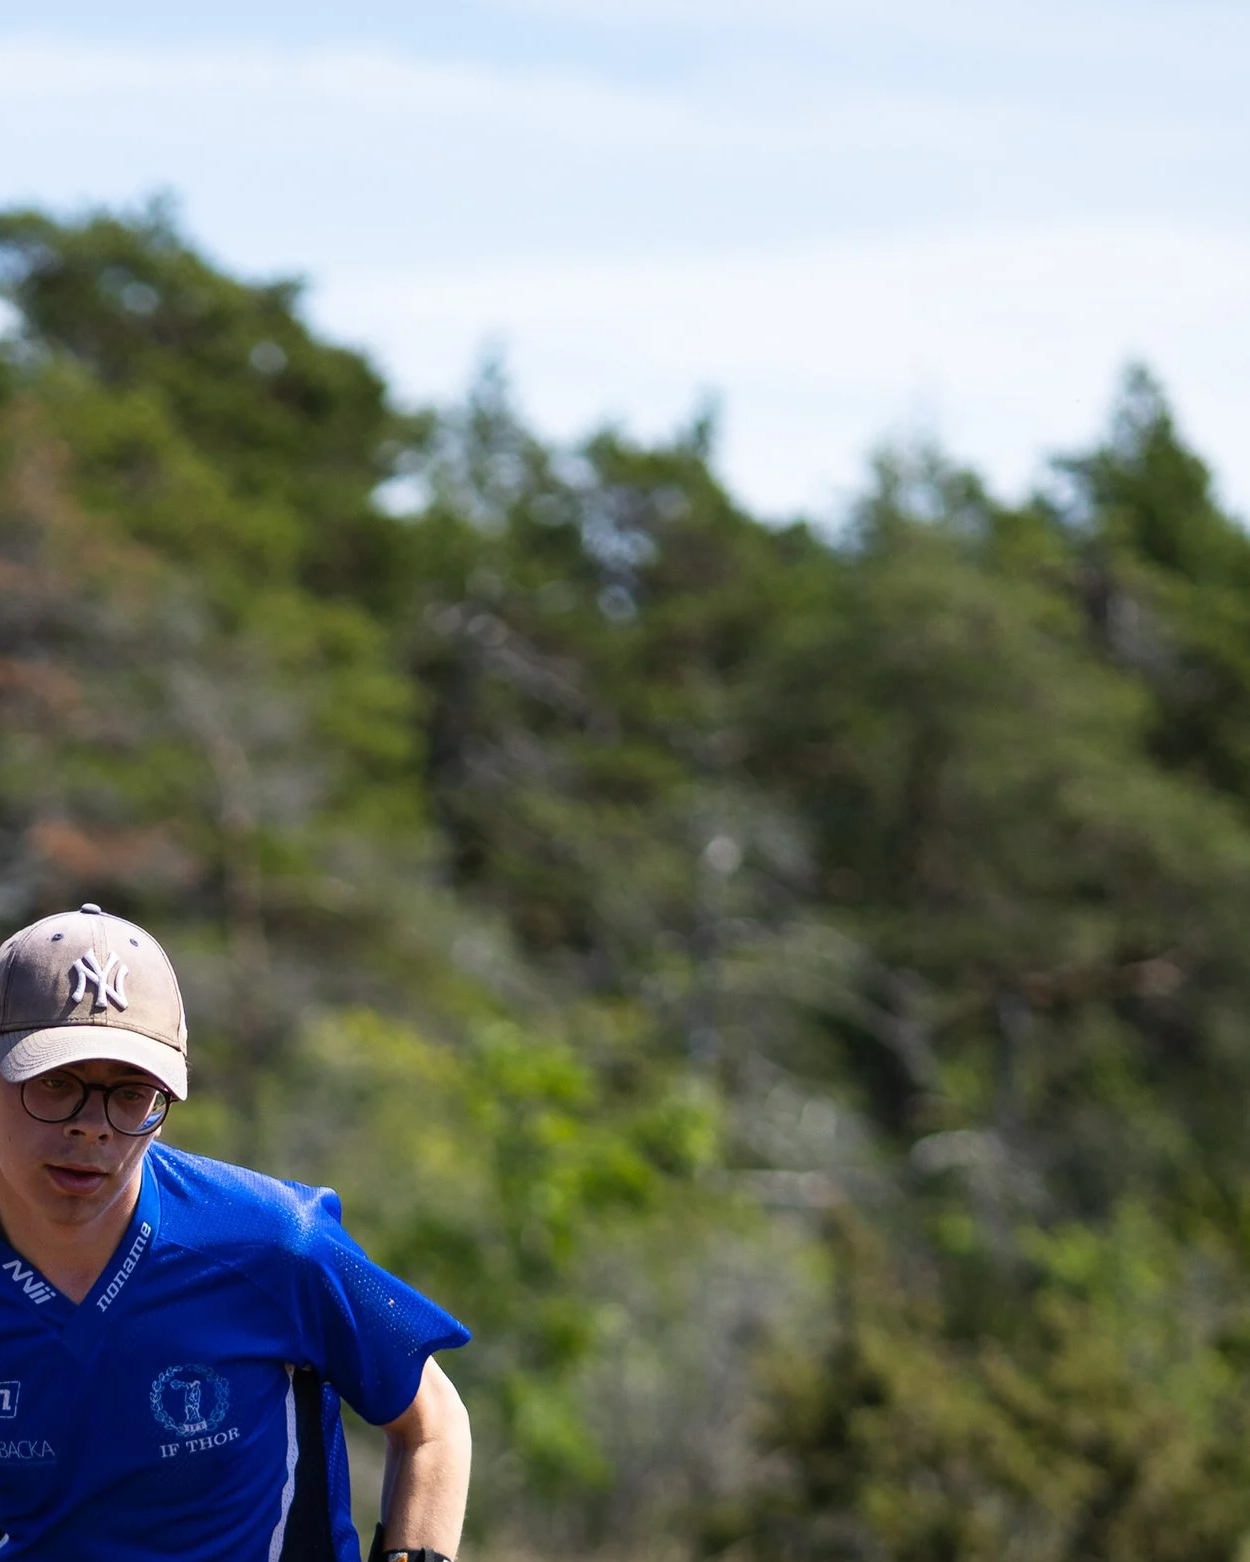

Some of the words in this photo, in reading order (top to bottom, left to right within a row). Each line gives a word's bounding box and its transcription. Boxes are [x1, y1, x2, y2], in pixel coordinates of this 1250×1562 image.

[96, 1221, 152, 1313] noname
[159, 1443, 180, 1458] IF
[185, 1427, 241, 1453] THOR
